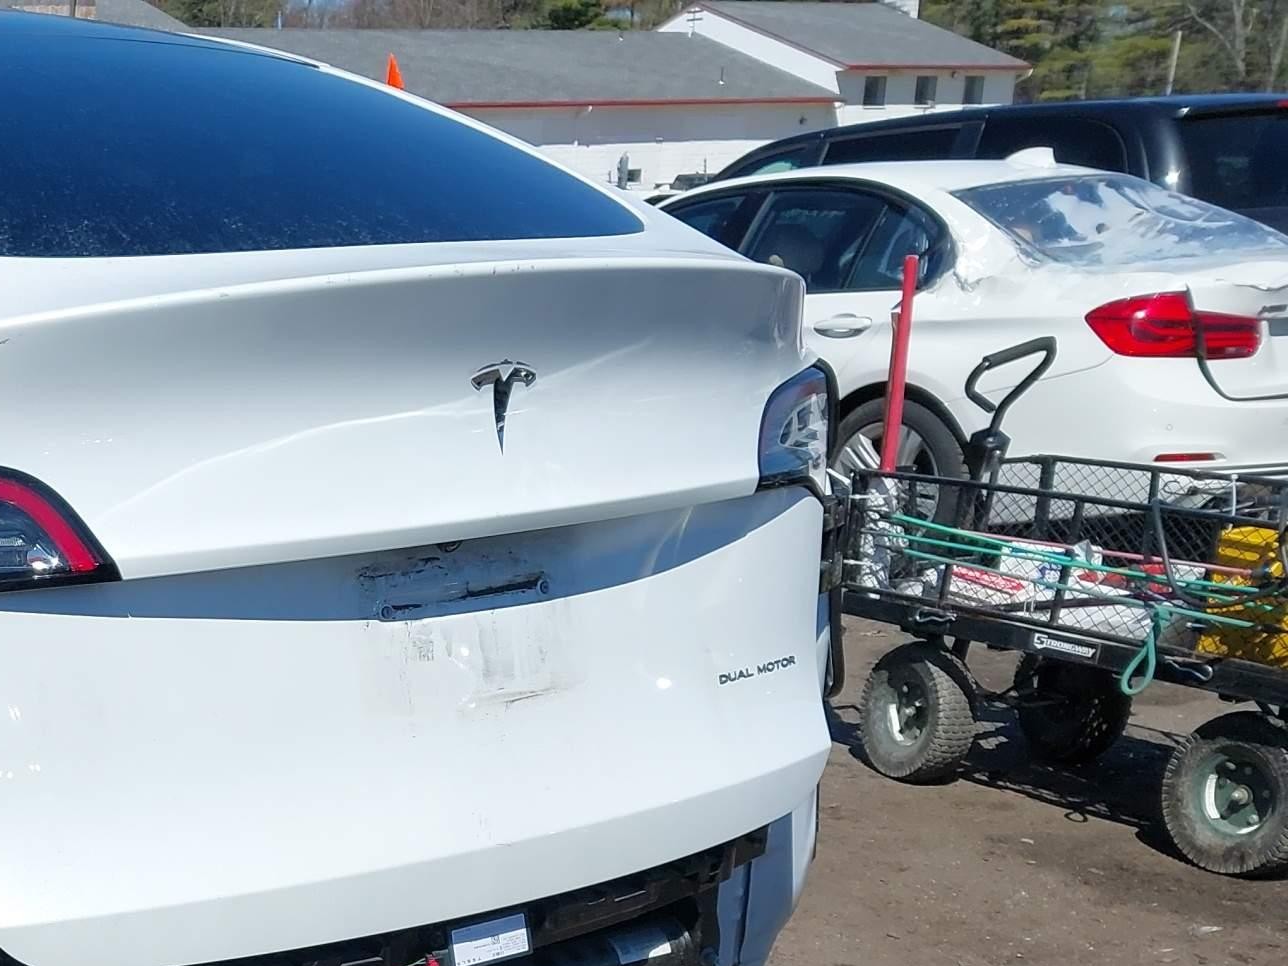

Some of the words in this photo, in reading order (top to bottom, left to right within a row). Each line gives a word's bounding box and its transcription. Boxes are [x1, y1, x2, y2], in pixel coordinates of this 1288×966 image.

[1033, 633, 1096, 658] STRONGWAY
[718, 667, 754, 685] DUAL
[757, 655, 796, 675] MOTOR
